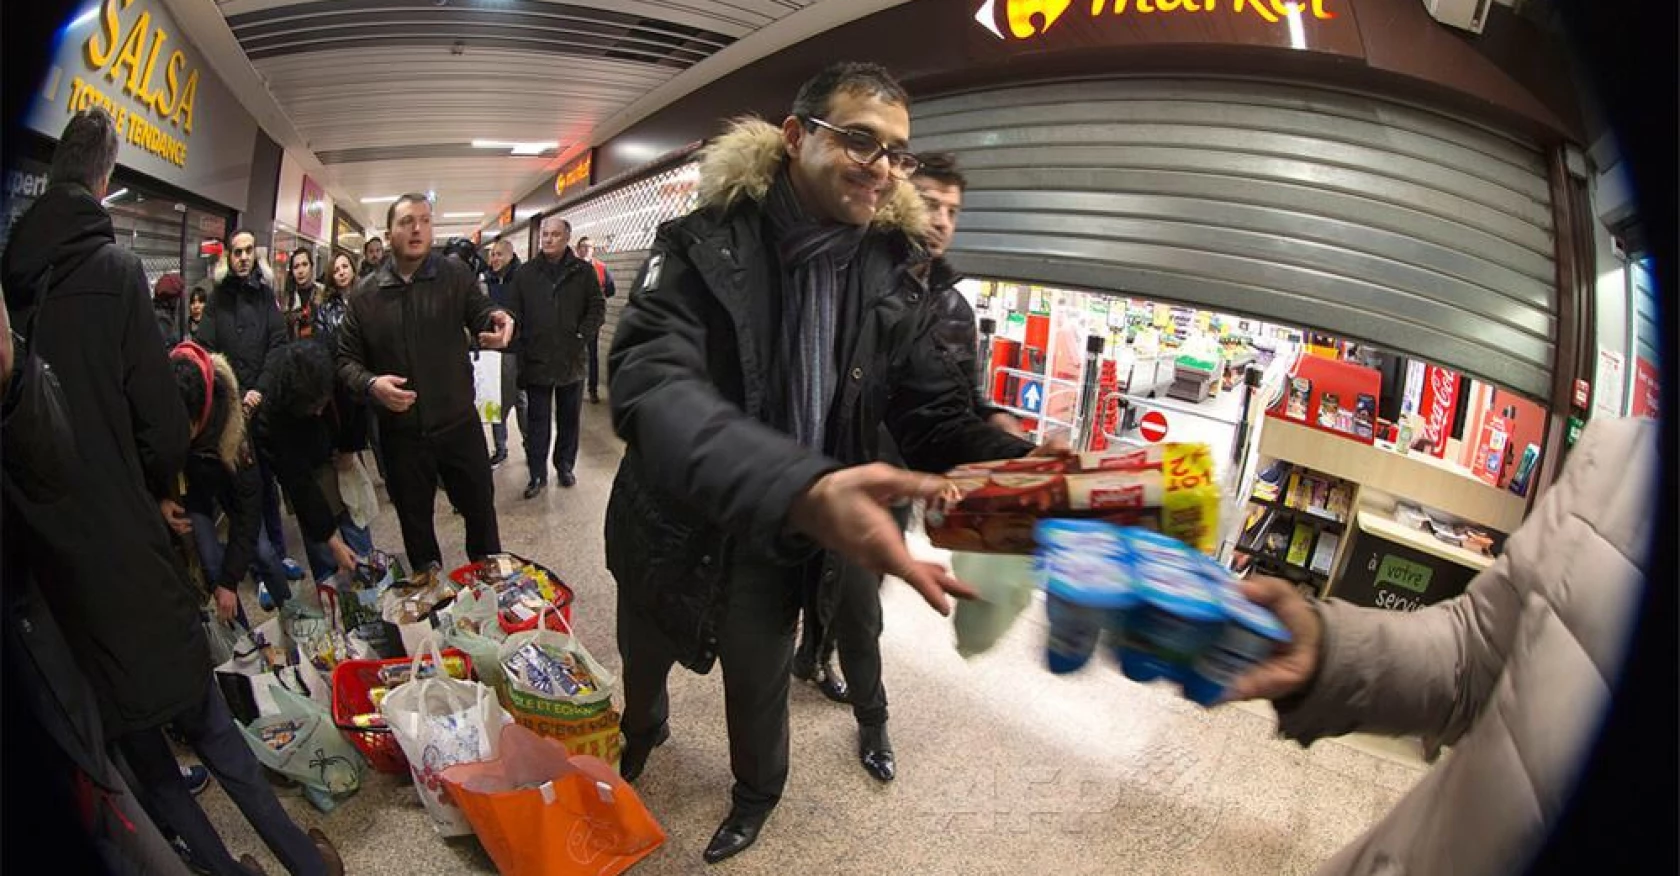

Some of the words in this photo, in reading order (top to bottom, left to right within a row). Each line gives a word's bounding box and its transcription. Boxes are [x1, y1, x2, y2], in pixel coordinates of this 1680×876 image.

[86, 0, 200, 135] SALSA
[125, 112, 188, 168] TENDANCE
[1387, 564, 1423, 588] votre
